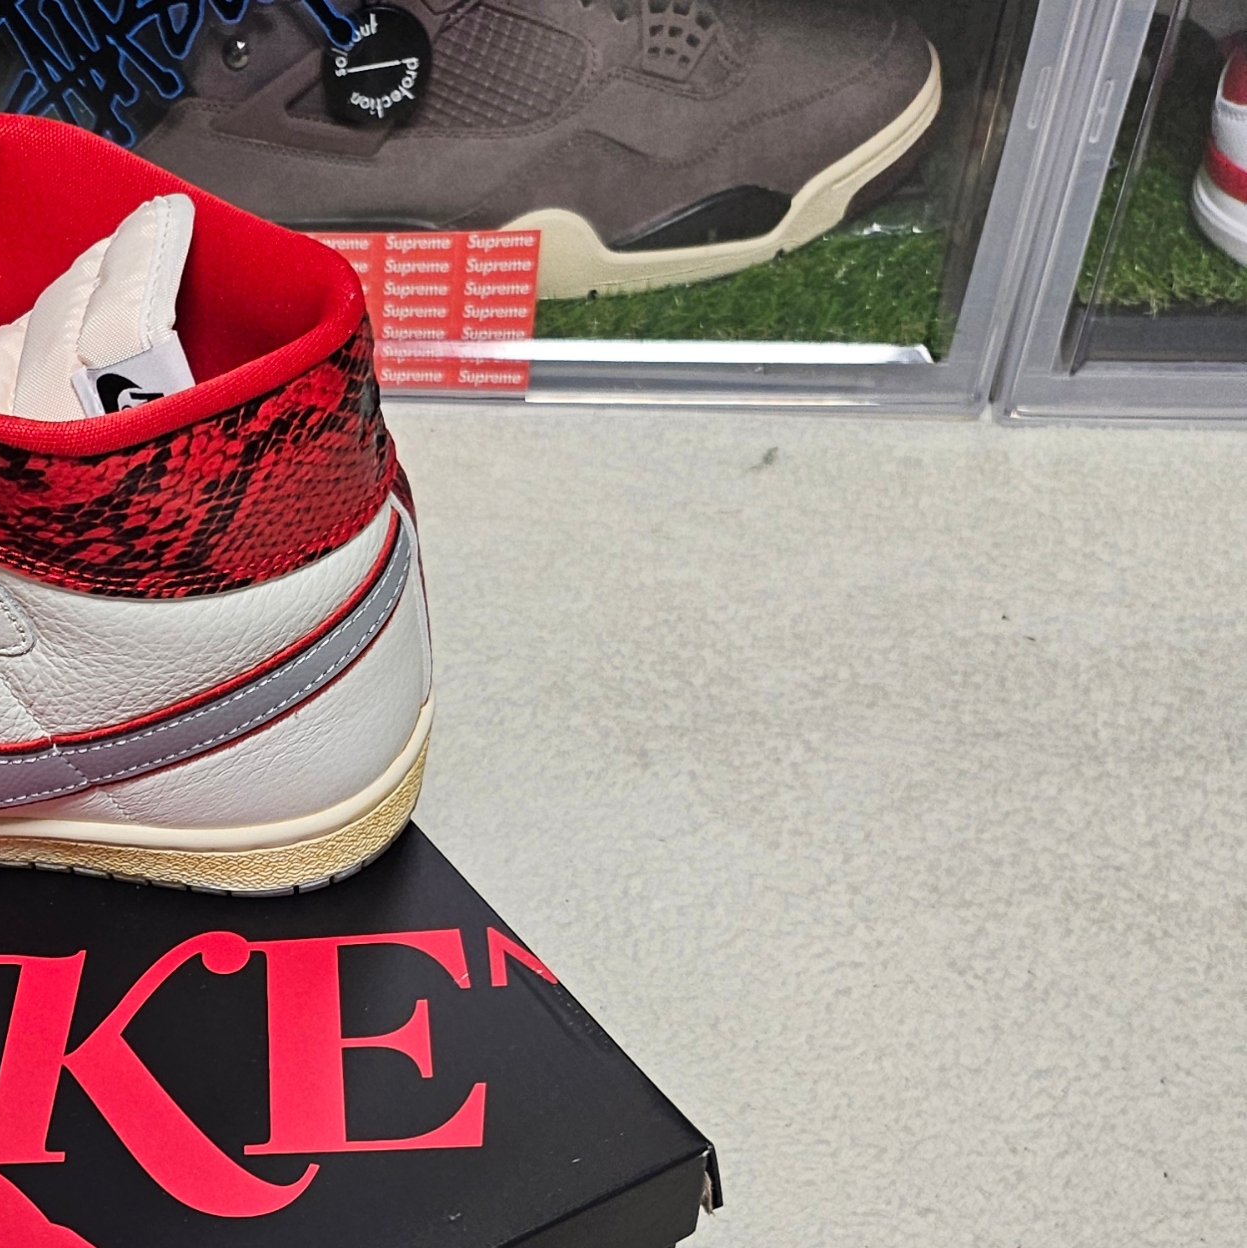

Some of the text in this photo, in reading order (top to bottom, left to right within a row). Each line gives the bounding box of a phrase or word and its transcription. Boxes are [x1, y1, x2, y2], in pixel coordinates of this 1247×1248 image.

[385, 234, 451, 254] Supreme
[467, 233, 535, 252] Supreme
[384, 258, 450, 277] Supreme
[465, 257, 532, 276] Supreme
[383, 281, 449, 299] Supreme
[463, 280, 530, 299] Supreme
[382, 303, 528, 322] Supreme Supreme
[381, 325, 526, 341] Supreme Supreme
[380, 367, 522, 387] Supreme Supreme
